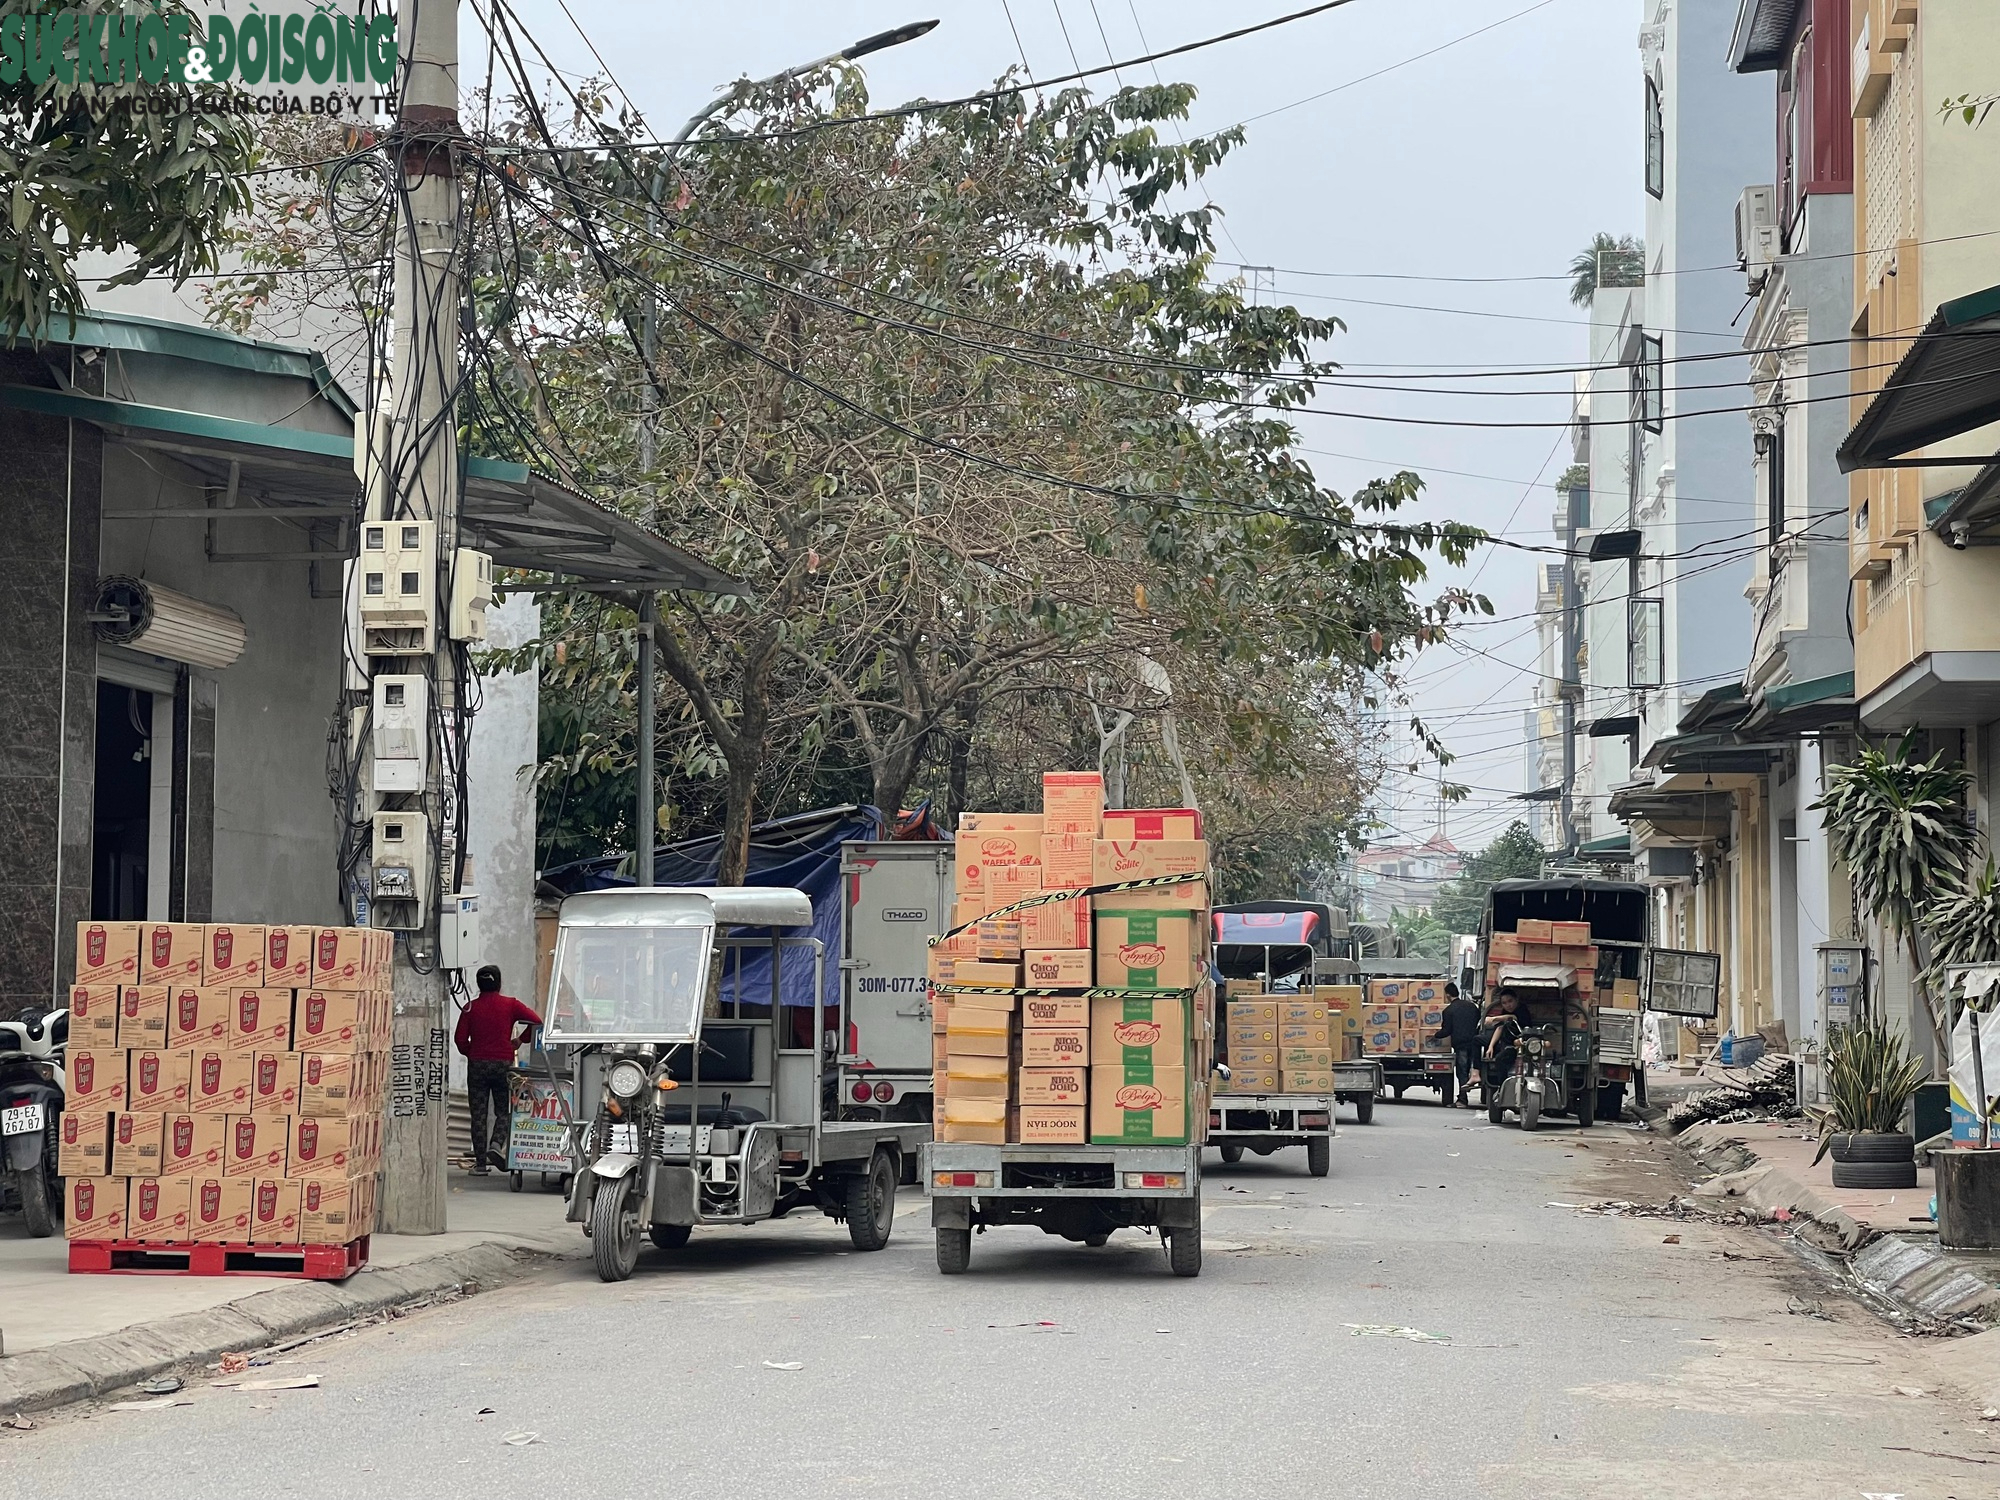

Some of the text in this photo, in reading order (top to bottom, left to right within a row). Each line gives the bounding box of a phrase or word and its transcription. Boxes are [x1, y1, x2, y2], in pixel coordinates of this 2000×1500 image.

[1115, 860, 1140, 872] Solite
[944, 986, 1058, 996] SCOTT
[1121, 1088, 1156, 1104] Belgi
[8, 1106, 36, 1120] 29-E2
[5, 1118, 40, 1133] 262.87
